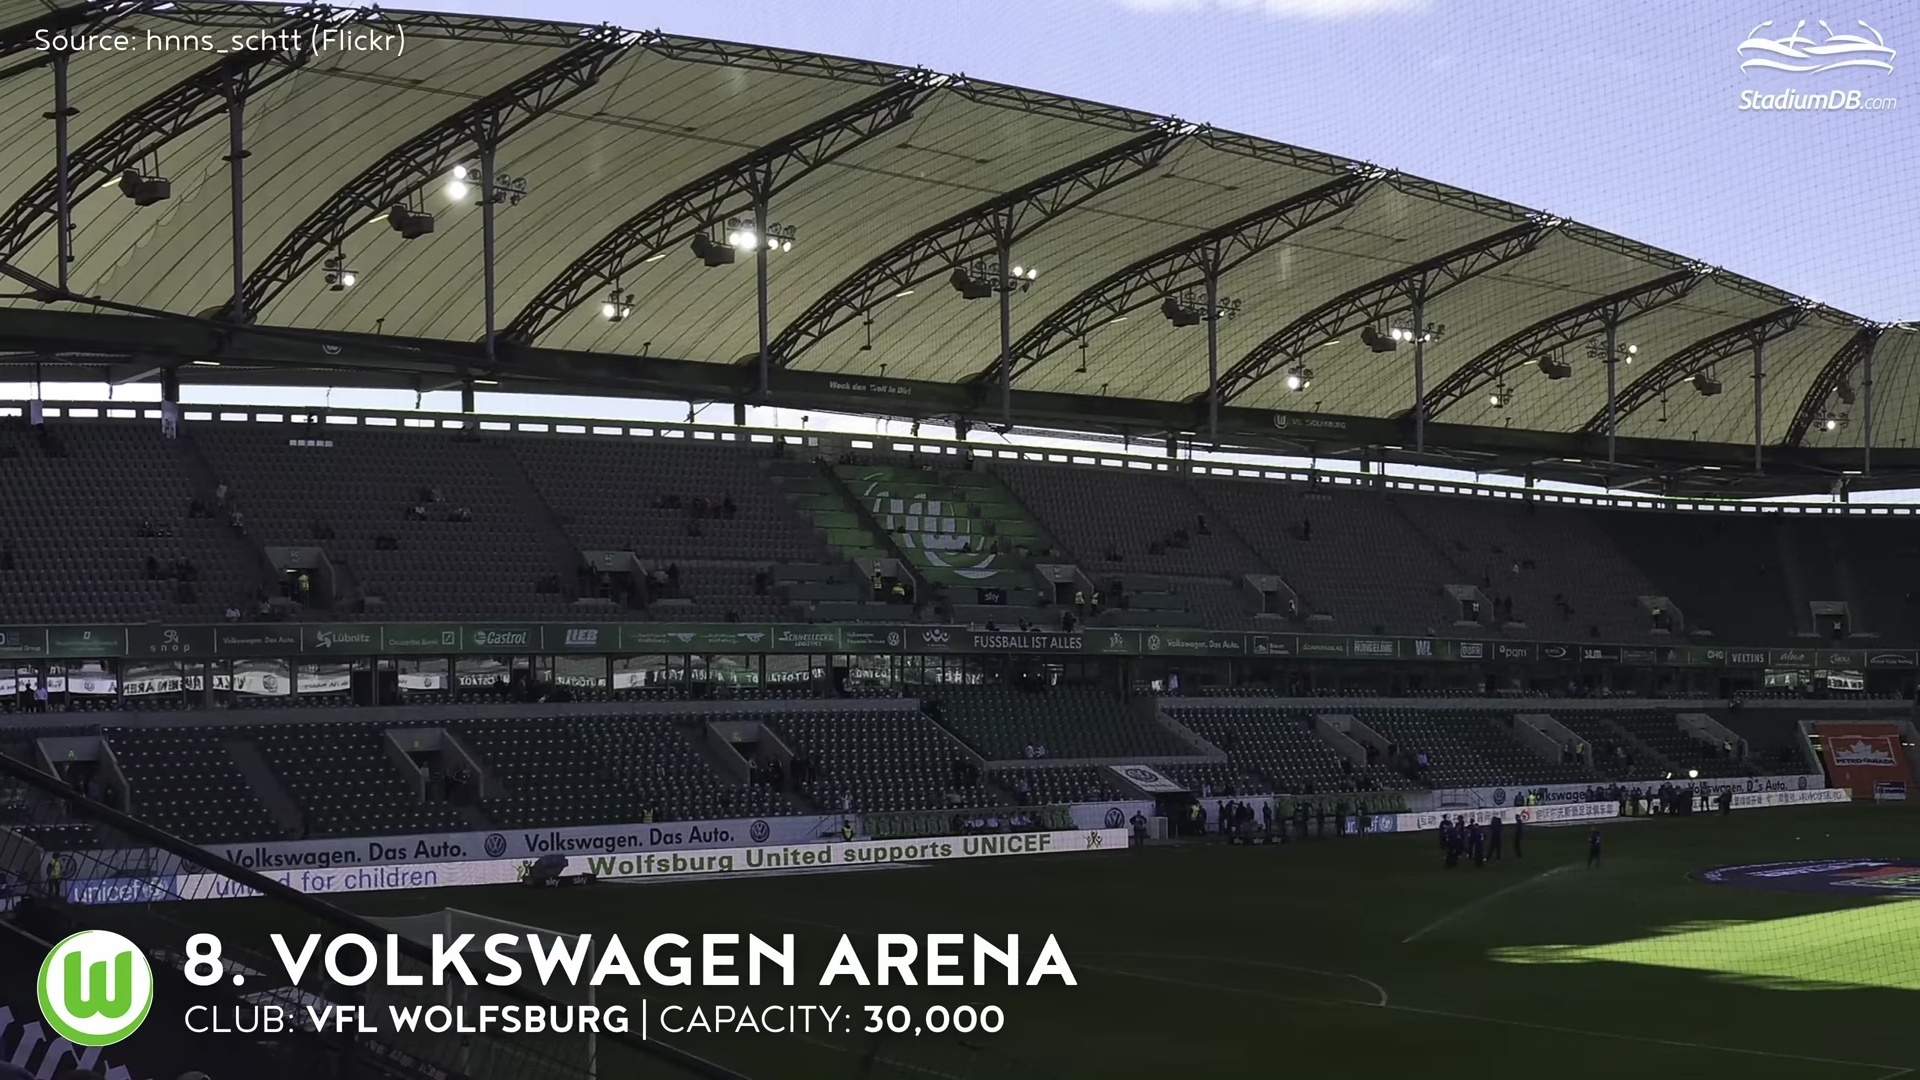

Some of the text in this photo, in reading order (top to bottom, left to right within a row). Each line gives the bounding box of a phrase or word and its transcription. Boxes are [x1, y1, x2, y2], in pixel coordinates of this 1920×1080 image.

[332, 633, 371, 644] Lübnitz
[486, 631, 527, 645] Castrol
[973, 636, 1082, 649] FUSSBALL IST ALLES
[1731, 653, 1765, 664] VELTINS
[1765, 778, 1788, 791] Auto.
[524, 826, 734, 858] Volkswagen. Das Auto.
[226, 840, 467, 872] Volkswagen. Das Auto.
[587, 834, 1051, 877] Wolfsburg United supports UNICEF
[302, 869, 334, 891] for
[344, 866, 438, 889] children
[572, 875, 588, 886] sky
